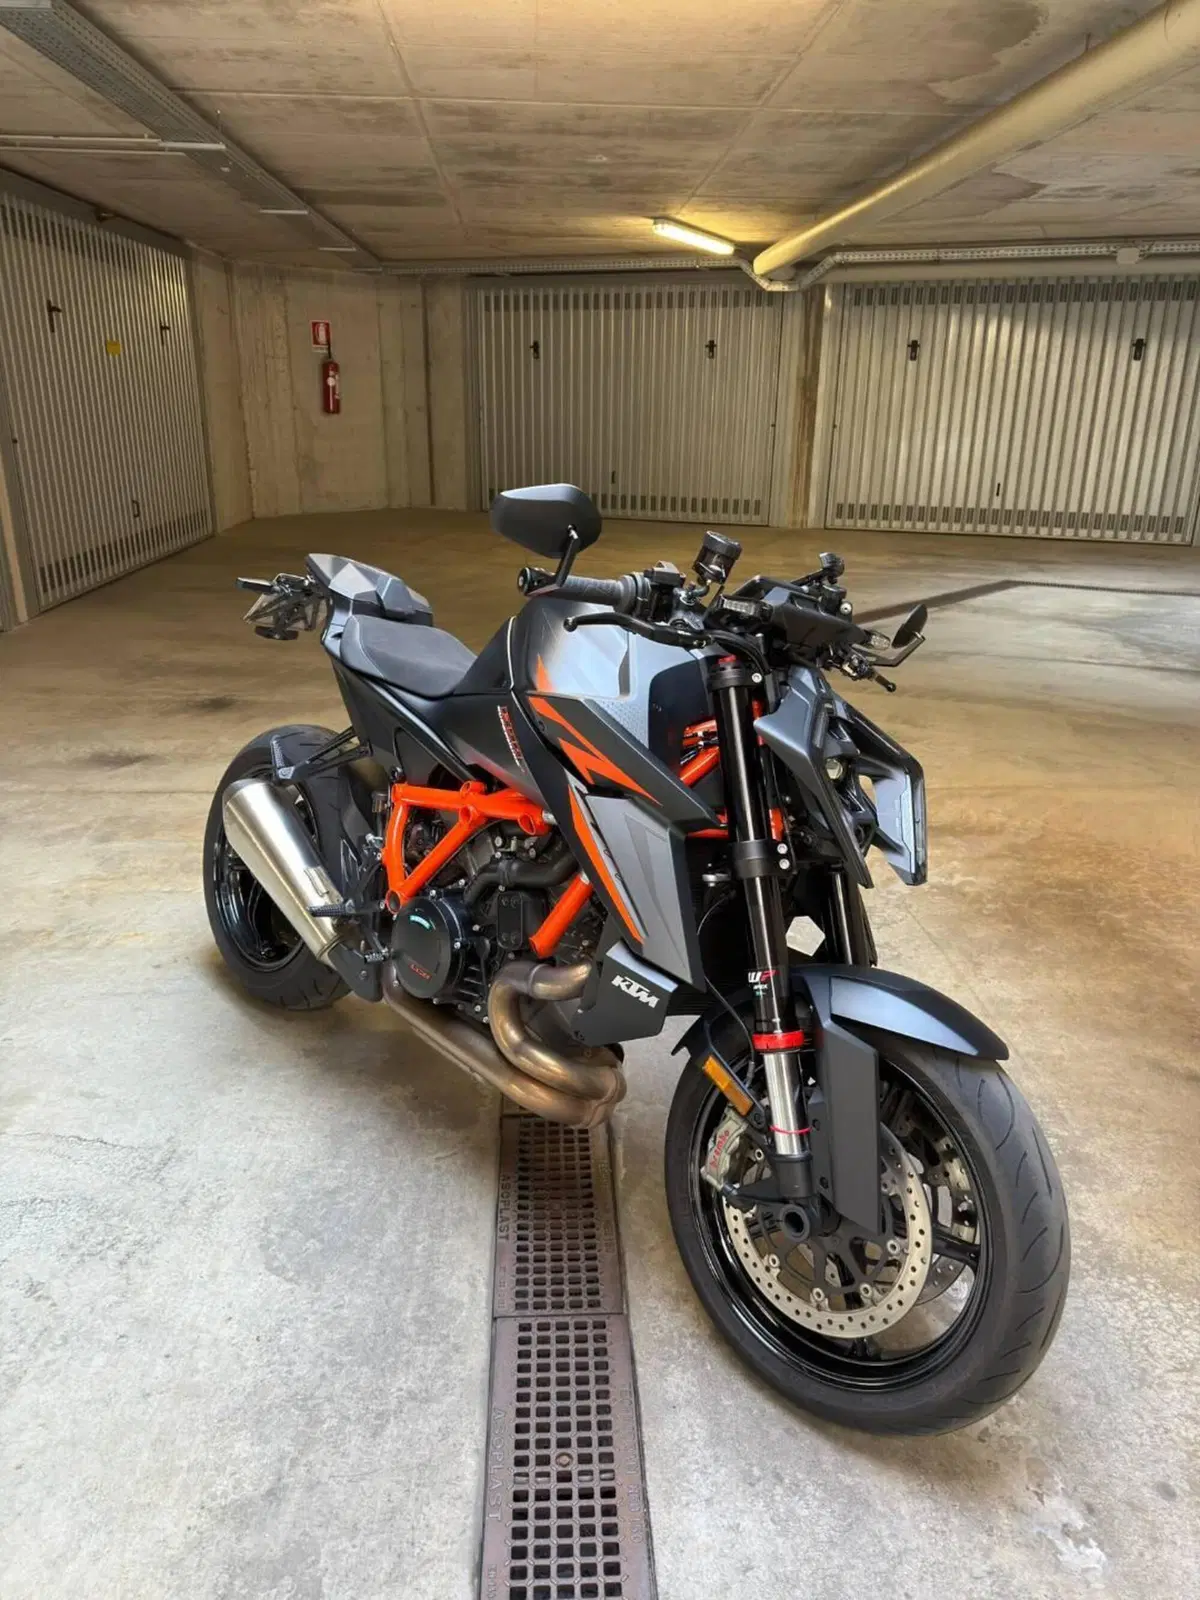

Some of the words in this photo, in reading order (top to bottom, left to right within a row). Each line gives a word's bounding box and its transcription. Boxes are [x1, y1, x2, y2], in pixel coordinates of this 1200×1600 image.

[611, 974, 660, 1008] KTM
[747, 969, 778, 983] WP
[486, 1408, 505, 1522] ASOPLAST
